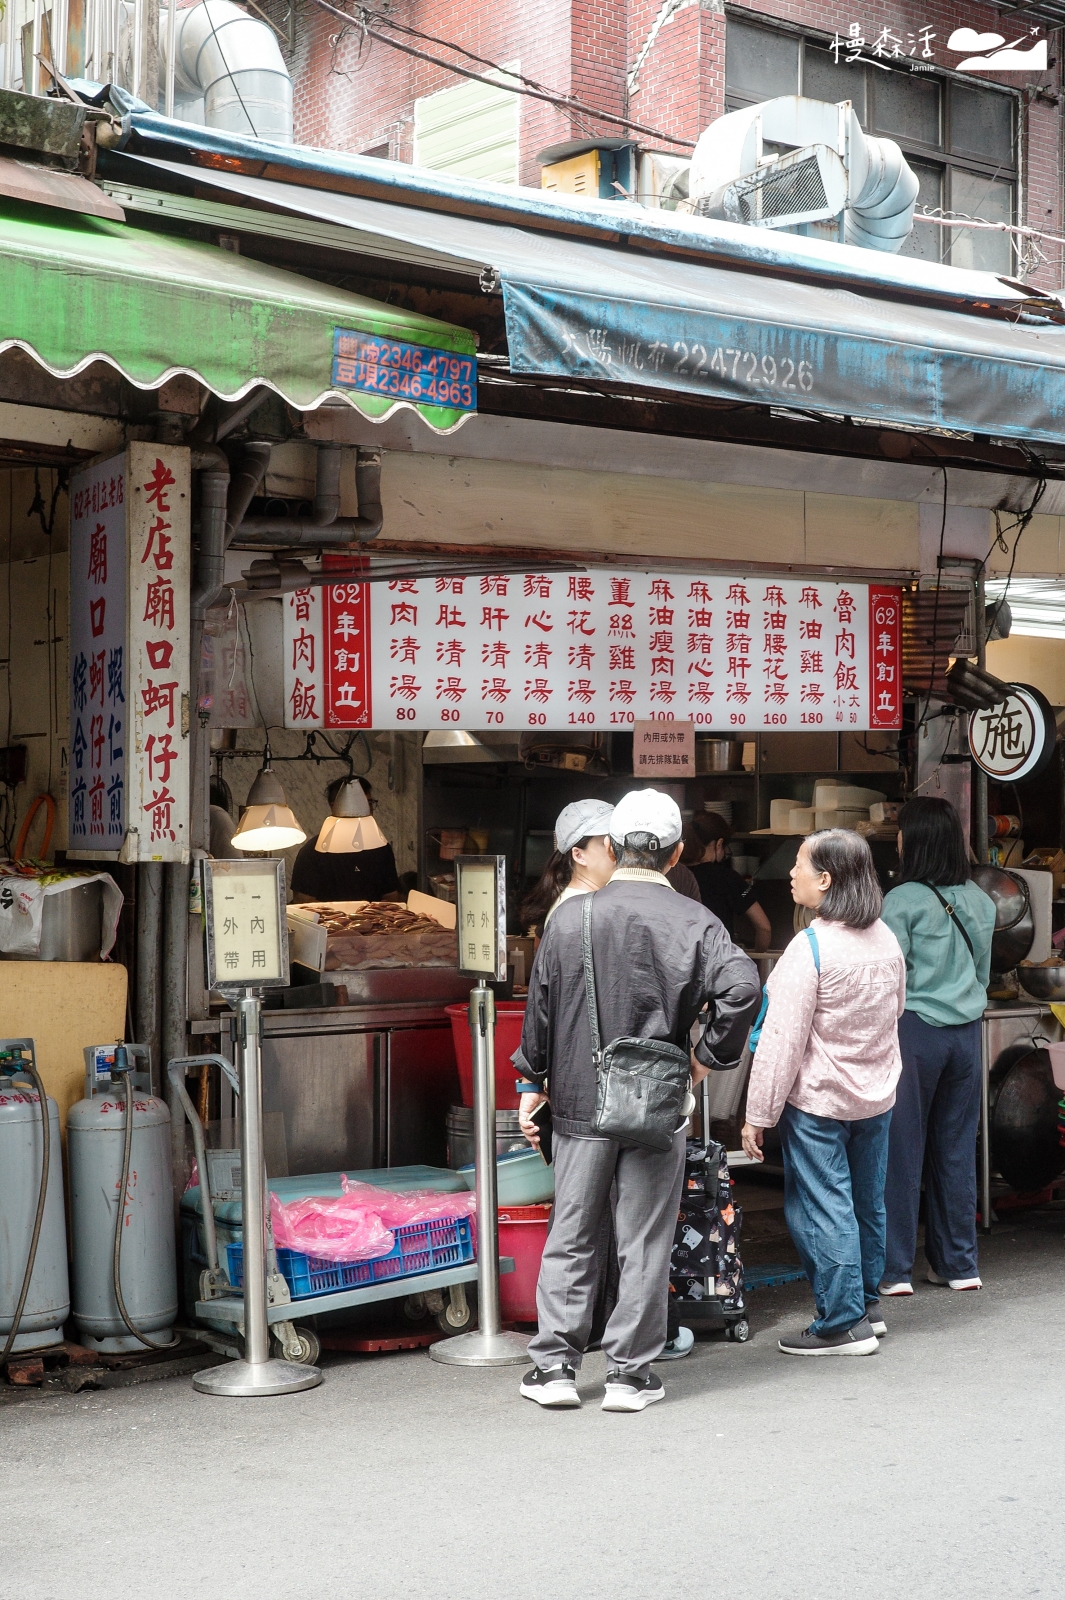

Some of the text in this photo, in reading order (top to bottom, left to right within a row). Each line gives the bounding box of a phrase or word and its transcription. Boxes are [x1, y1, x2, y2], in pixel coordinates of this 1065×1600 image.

[74, 474, 124, 521] 62年創立老店
[88, 523, 107, 836] 廟口蚵仔煎
[141, 457, 179, 842] 老店廟口蚵仔煎
[332, 583, 362, 707] 62年創立
[435, 575, 467, 722] 豬肚清湯 80
[480, 575, 511, 724] 豬肝清湯 70
[523, 575, 553, 725] 豬心清湯 80
[567, 575, 596, 725] 腰花清湯 140
[648, 579, 677, 721] 麻油瘦肉湯 100
[687, 580, 714, 725] 麻油豬心湯 100
[726, 583, 752, 725] 麻油豬肝湯 90
[763, 584, 789, 725] 麻油腰花湯 160
[799, 586, 824, 725] 麻油雞湯 180
[833, 589, 860, 690] 魯肉飯
[875, 606, 896, 712] 62年創立
[72, 649, 88, 836] 綜合煎
[107, 645, 125, 836] 蝦仁煎
[396, 708, 416, 720] 80
[609, 711, 635, 724] 170
[643, 732, 685, 743] 內用或外帶
[833, 694, 860, 707] 小 大
[835, 711, 857, 723] 40 50
[979, 700, 1026, 760] 施
[639, 754, 689, 765] 請先排隊點餐
[223, 916, 239, 969] 外帶
[250, 915, 266, 968] 內用
[466, 910, 476, 960] 內用
[480, 910, 491, 961] 外帶
